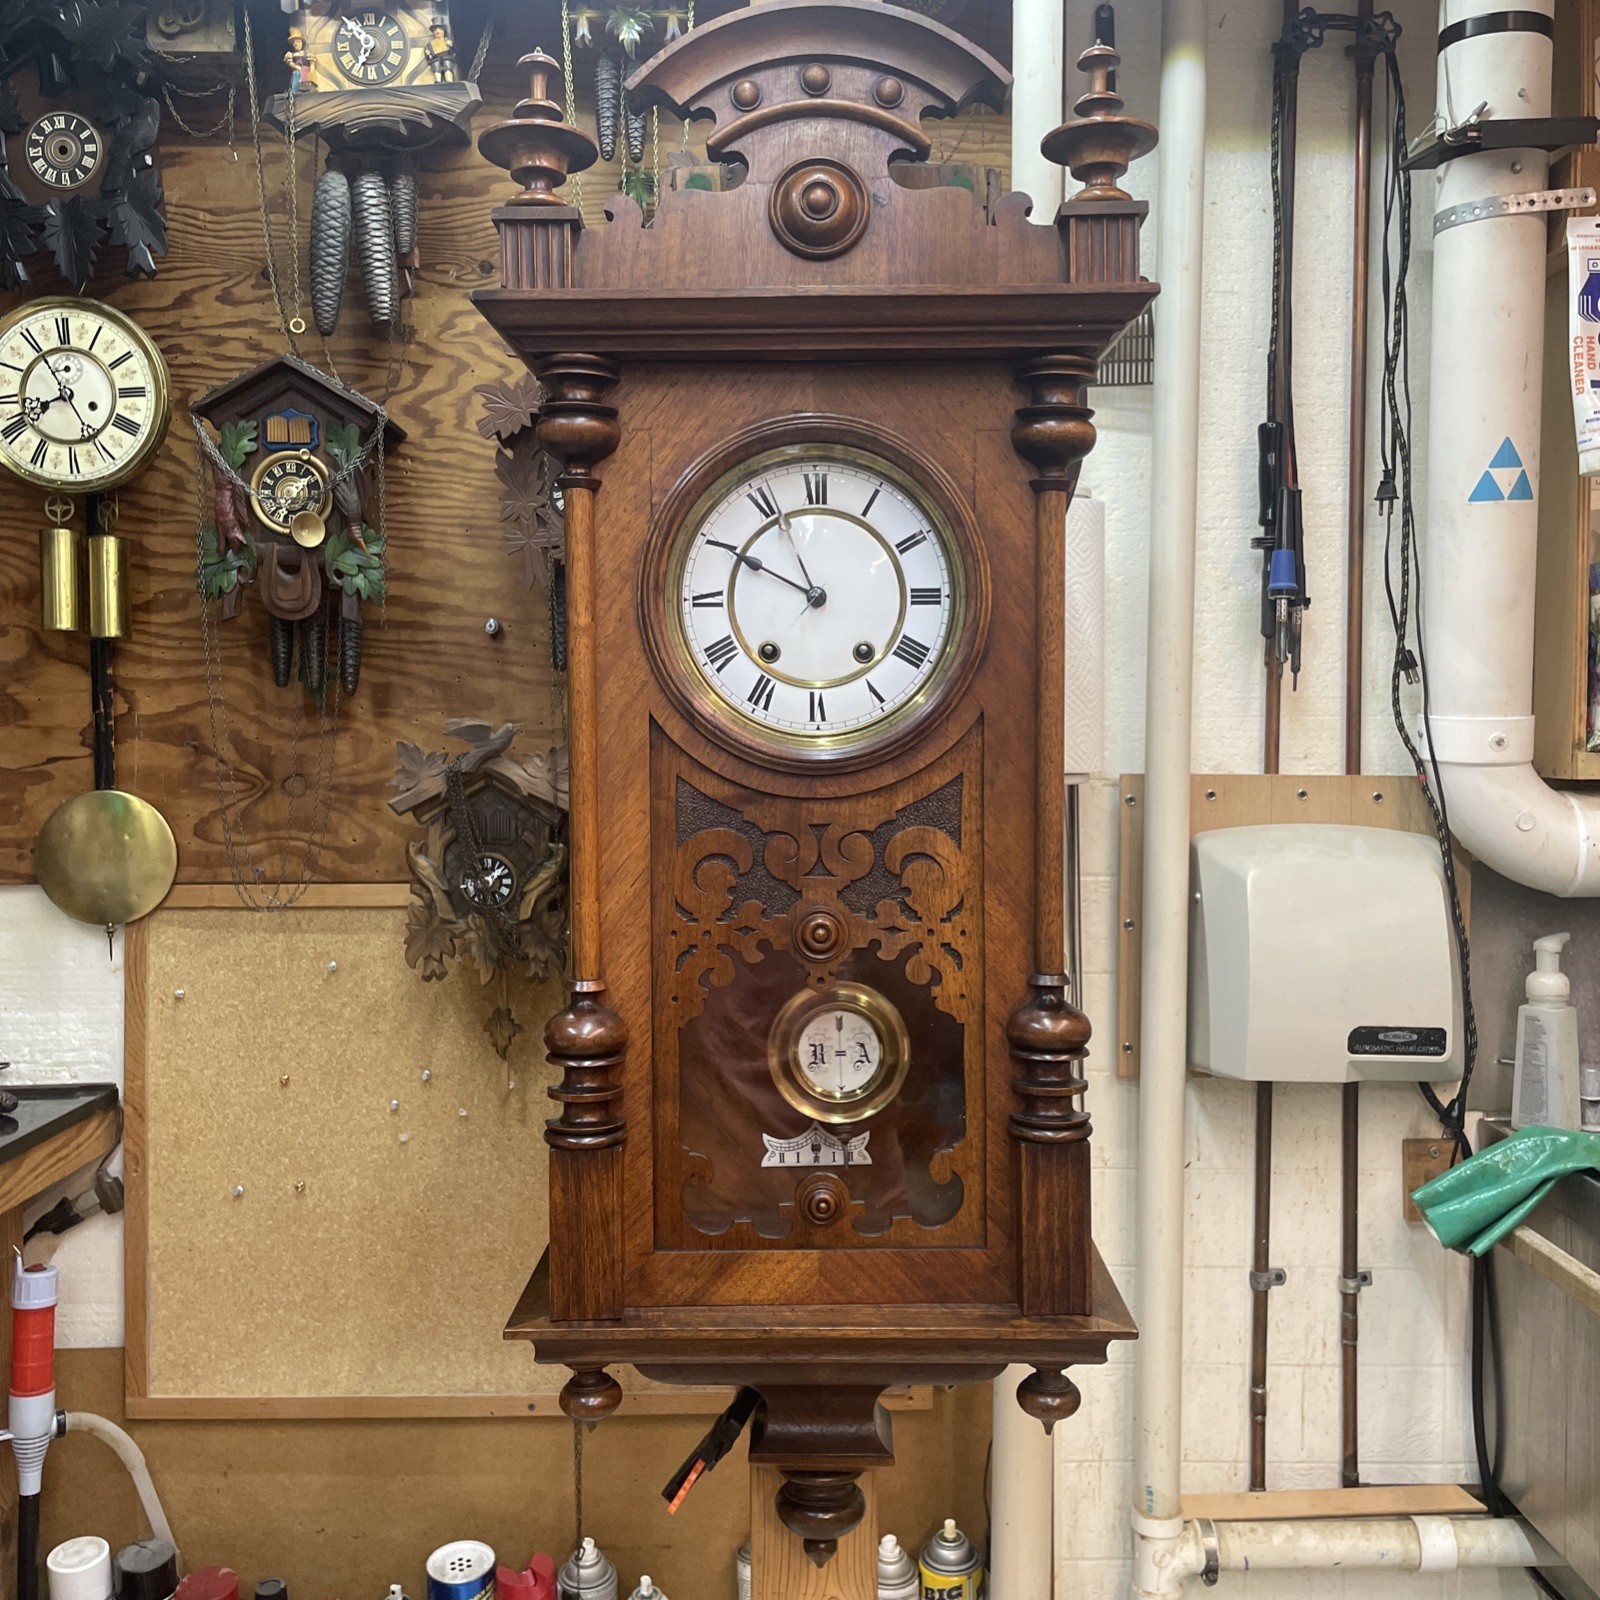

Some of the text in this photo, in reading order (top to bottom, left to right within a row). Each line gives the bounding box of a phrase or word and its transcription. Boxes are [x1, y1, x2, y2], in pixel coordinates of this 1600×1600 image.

[40, 120, 53, 134] XI
[53, 116, 66, 129] XII
[80, 129, 92, 140] II
[31, 132, 44, 144] X
[84, 144, 96, 152] III
[28, 146, 42, 157] IX
[44, 168, 57, 183] VII
[62, 172, 70, 186] VI
[75, 168, 84, 180] V
[20, 328, 43, 354] XI
[55, 318, 70, 346] XII
[88, 326, 102, 351] I
[108, 350, 134, 370] II
[1586, 336, 1596, 370] HAND
[1574, 336, 1584, 396] CLEANER
[118, 386, 146, 398] III
[0, 416, 29, 445] VIII
[112, 412, 141, 437] IIII
[30, 438, 49, 468] VII
[68, 446, 80, 474] VI
[803, 474, 828, 505] XII
[746, 486, 776, 522] XI
[862, 488, 881, 518] I
[704, 532, 738, 558] X
[896, 530, 928, 555] II
[692, 590, 724, 608] IX
[910, 588, 942, 606] III
[704, 634, 739, 674] VIII
[892, 634, 932, 670] IIII
[748, 674, 776, 712] VII
[866, 678, 886, 707] V
[810, 692, 826, 722] VI
[853, 1041, 872, 1072] A
[924, 1584, 963, 1600] BIG
